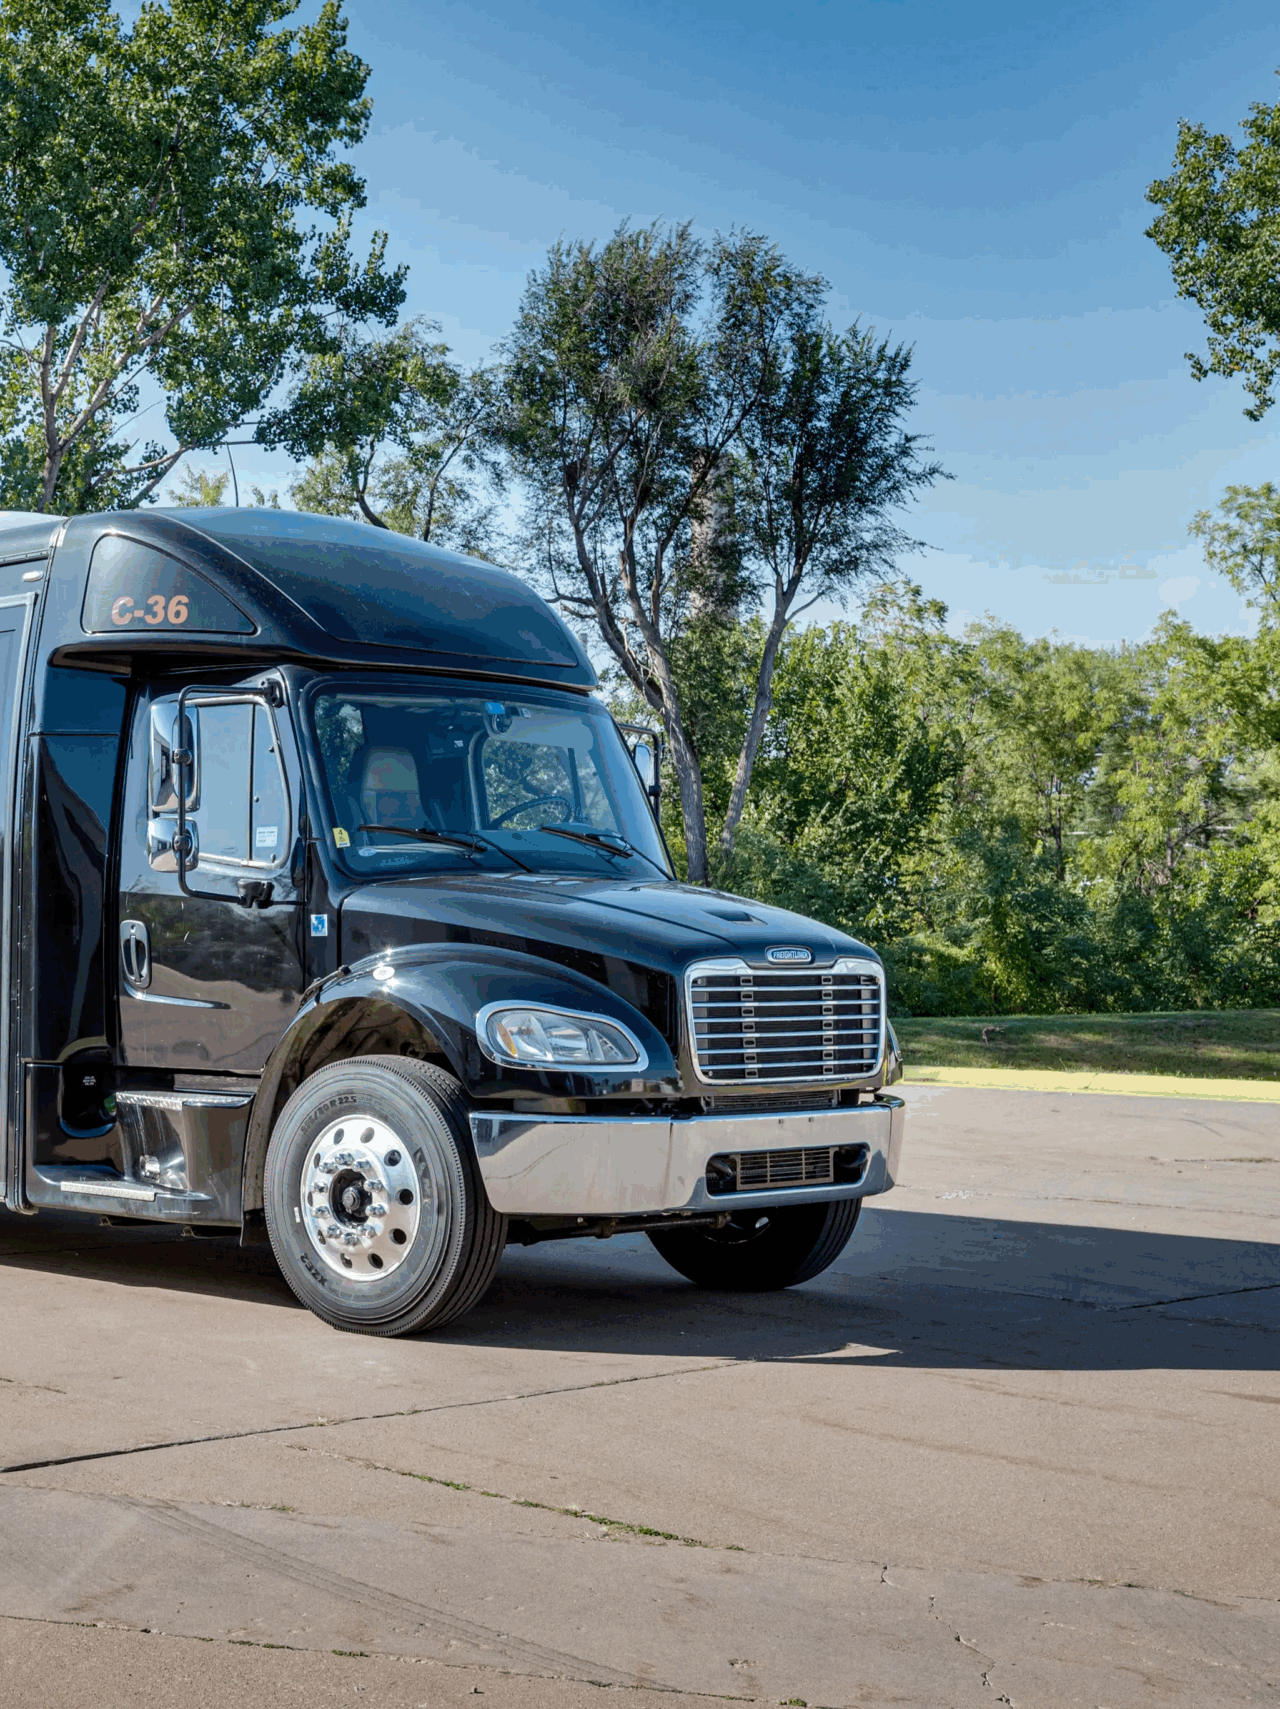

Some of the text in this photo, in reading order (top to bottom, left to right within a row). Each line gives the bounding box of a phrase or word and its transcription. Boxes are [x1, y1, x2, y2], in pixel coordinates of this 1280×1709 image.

[111, 594, 190, 625] C-36
[773, 950, 808, 959] FREIGHTLINER
[300, 1251, 329, 1288] XZE2
